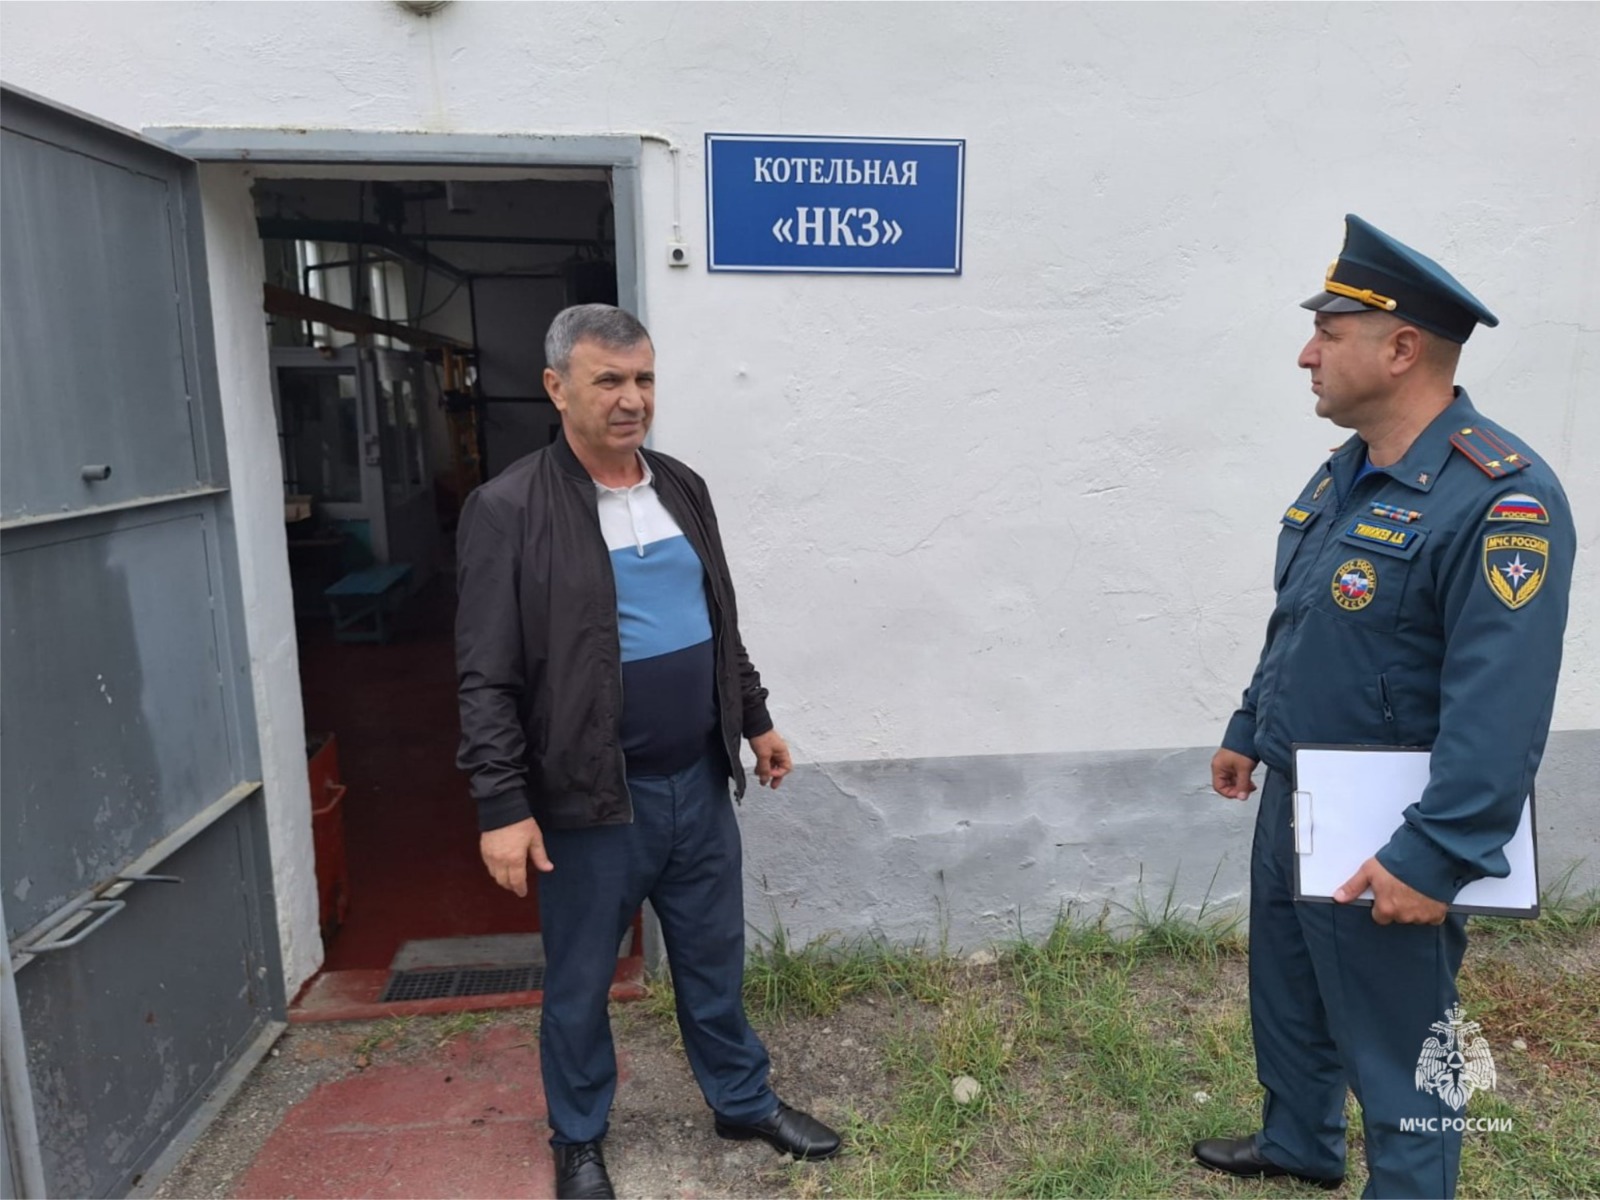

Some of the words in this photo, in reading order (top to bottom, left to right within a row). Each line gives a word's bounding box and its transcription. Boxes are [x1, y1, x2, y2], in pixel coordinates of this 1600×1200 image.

[754, 156, 918, 186] КОТЕЛЬНАЯ
[772, 206, 903, 247] «НКЗ»
[1488, 536, 1510, 548] МЧС
[1511, 536, 1547, 553] РОССИИ
